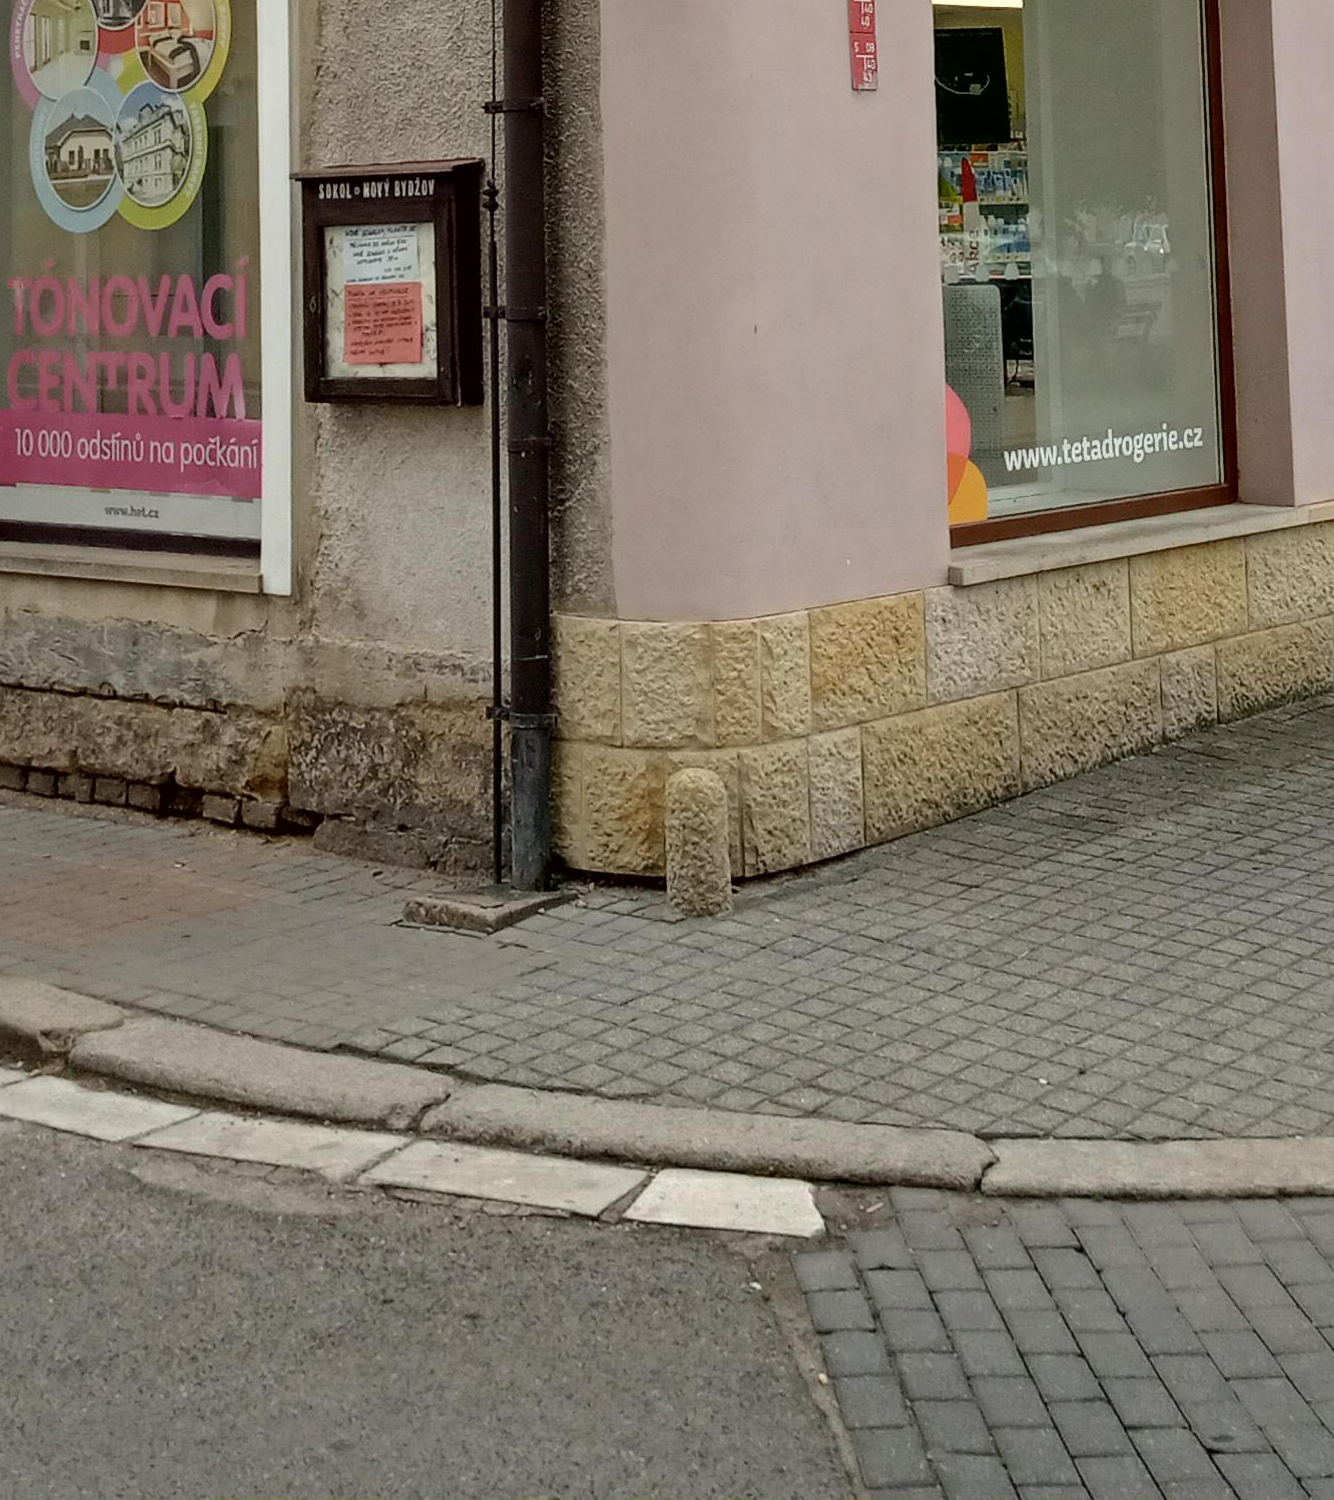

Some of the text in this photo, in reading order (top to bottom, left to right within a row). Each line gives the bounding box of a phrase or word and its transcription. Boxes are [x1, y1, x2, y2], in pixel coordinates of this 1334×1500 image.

[319, 177, 435, 199] SOKOL NOVÝ BYDŽOV
[7, 255, 251, 340] TÓNOVACÍ
[6, 349, 247, 420] CENTRUM
[15, 428, 259, 473] 10 000 odstínů na počkání
[1003, 422, 1204, 472] www.tetadrogerie.cz
[104, 504, 160, 519] www.het.cz
